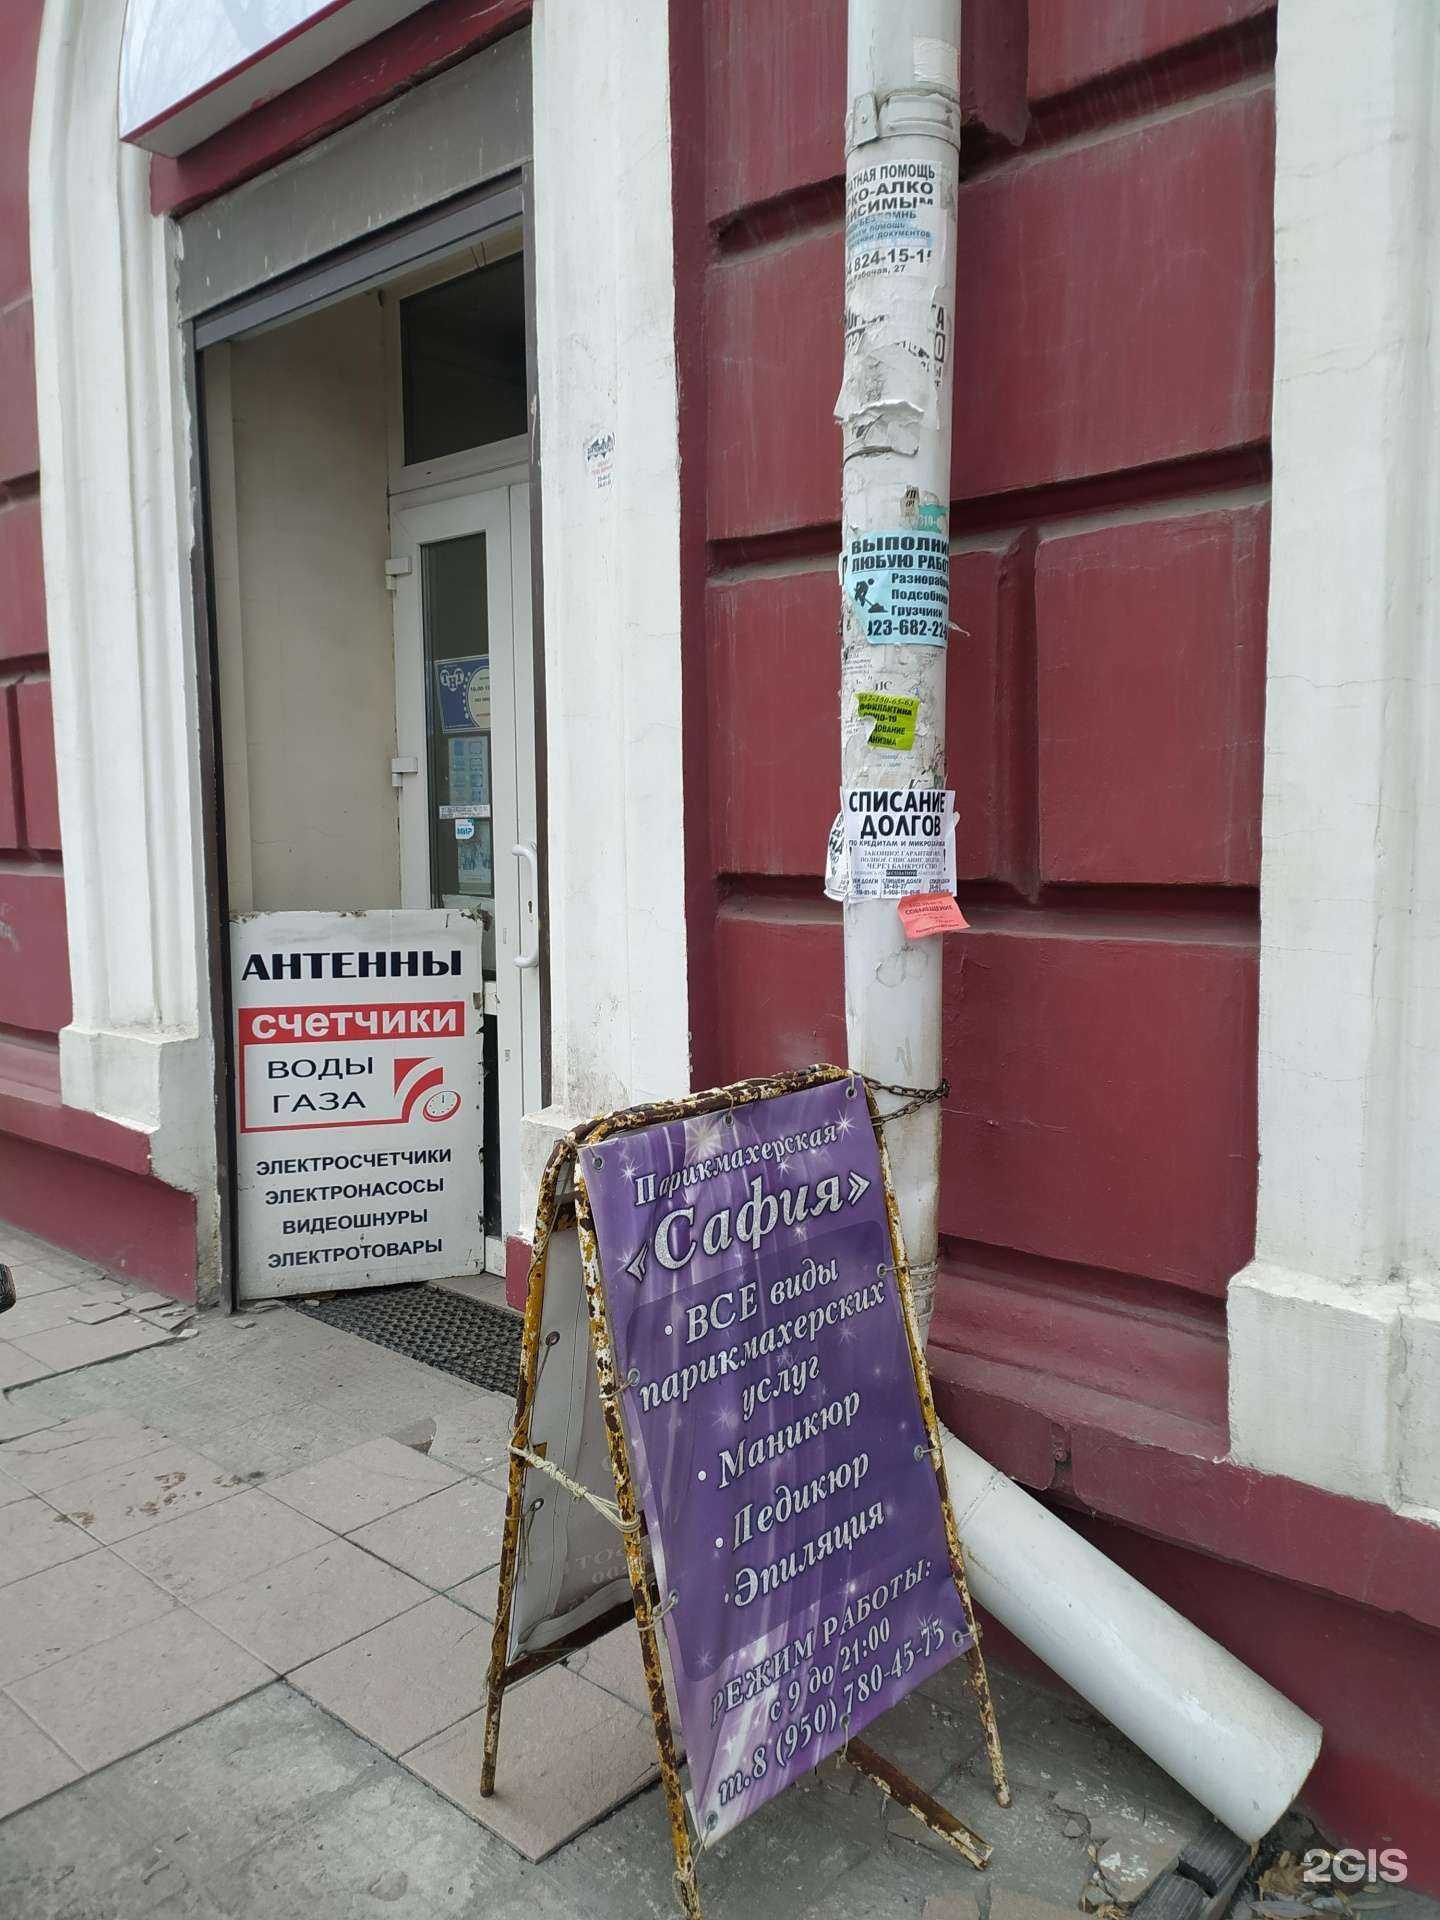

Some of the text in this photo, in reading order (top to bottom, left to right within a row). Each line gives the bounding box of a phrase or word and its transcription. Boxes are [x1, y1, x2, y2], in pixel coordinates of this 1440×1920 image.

[880, 163, 935, 180] ПОМОЩЬ
[894, 264, 906, 273] 27
[852, 536, 949, 555] ВЫПОЛНИ
[852, 554, 914, 572] ЛЮБУЮ
[891, 605, 943, 618] Грузчики
[849, 790, 946, 813] СПИСАНИЕ
[860, 814, 941, 840] ДОЛГОВ
[859, 839, 899, 848] КРЕДИТАМ
[241, 950, 462, 981] АНТЕННЫ
[267, 1056, 373, 1081] ВОДЫ
[273, 1091, 366, 1114] ГАЗА
[256, 1148, 452, 1176] ЭЛЕКТРОСЧЕТЧИКИ
[634, 1123, 838, 1206] Парикмахерская
[265, 1177, 445, 1205] ЭЛЕКТРОНАСОСЫ
[282, 1208, 428, 1235] ВИДЕОШНУРЫ
[626, 1170, 872, 1283] «Сафия»
[267, 1238, 443, 1268] ЭЛЕКТРОТОВАРЫ
[685, 1256, 839, 1344] ВСЕ виды
[639, 1280, 886, 1412] парикмахерских
[742, 1355, 820, 1421] услуг
[718, 1391, 860, 1489] Маникюр
[732, 1452, 870, 1550] Педикюр
[734, 1500, 886, 1607] Эпиляция
[710, 1559, 932, 1727] РЕЖИМ РАБОТЫ:
[787, 1681, 801, 1712] 9
[809, 1664, 834, 1695] до
[840, 1616, 891, 1672] 21:00
[775, 1697, 837, 1767] (950)
[842, 1616, 945, 1717] 780-45-75
